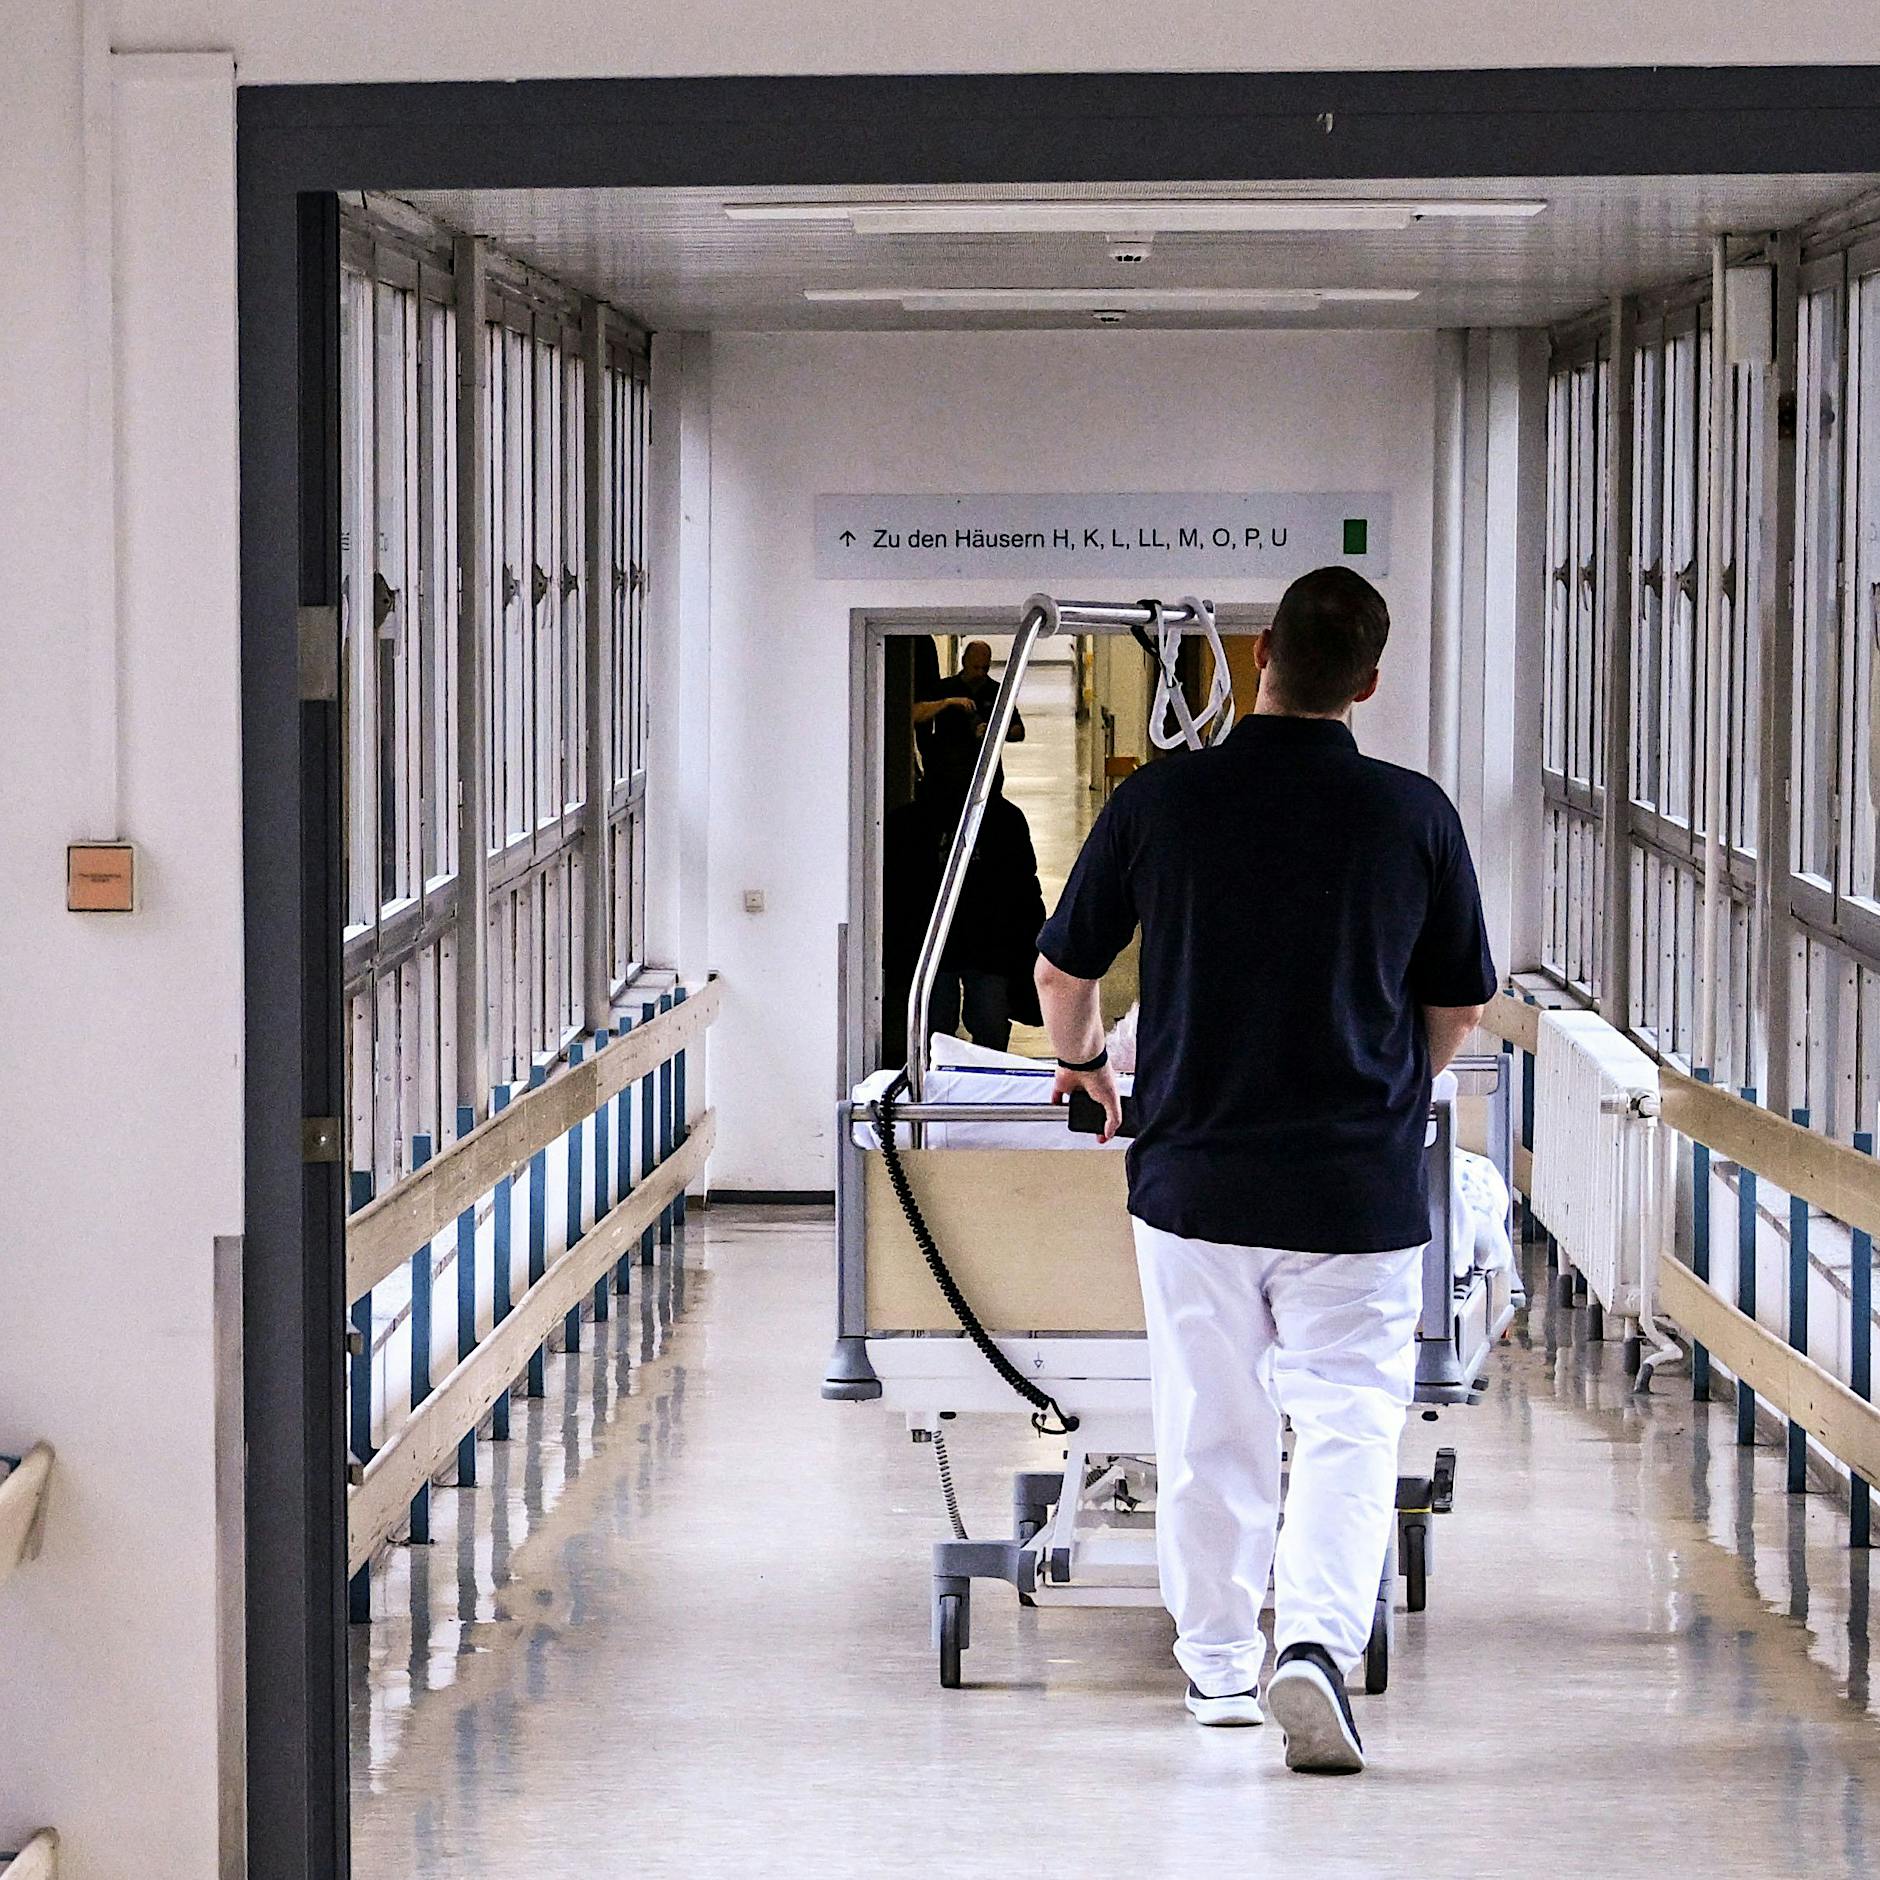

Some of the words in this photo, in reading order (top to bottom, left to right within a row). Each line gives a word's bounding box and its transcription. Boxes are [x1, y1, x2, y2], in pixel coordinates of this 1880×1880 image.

[872, 528, 901, 549] Zu
[907, 528, 948, 549] den
[955, 524, 1045, 549] Häusern
[1053, 527, 1075, 552] H,
[1083, 528, 1105, 551] K,
[1111, 528, 1131, 551] L,
[1138, 527, 1171, 551] LL,
[1179, 527, 1204, 550] M,
[1212, 527, 1237, 550] O,
[1244, 527, 1263, 551] P,
[1271, 527, 1288, 548] U
